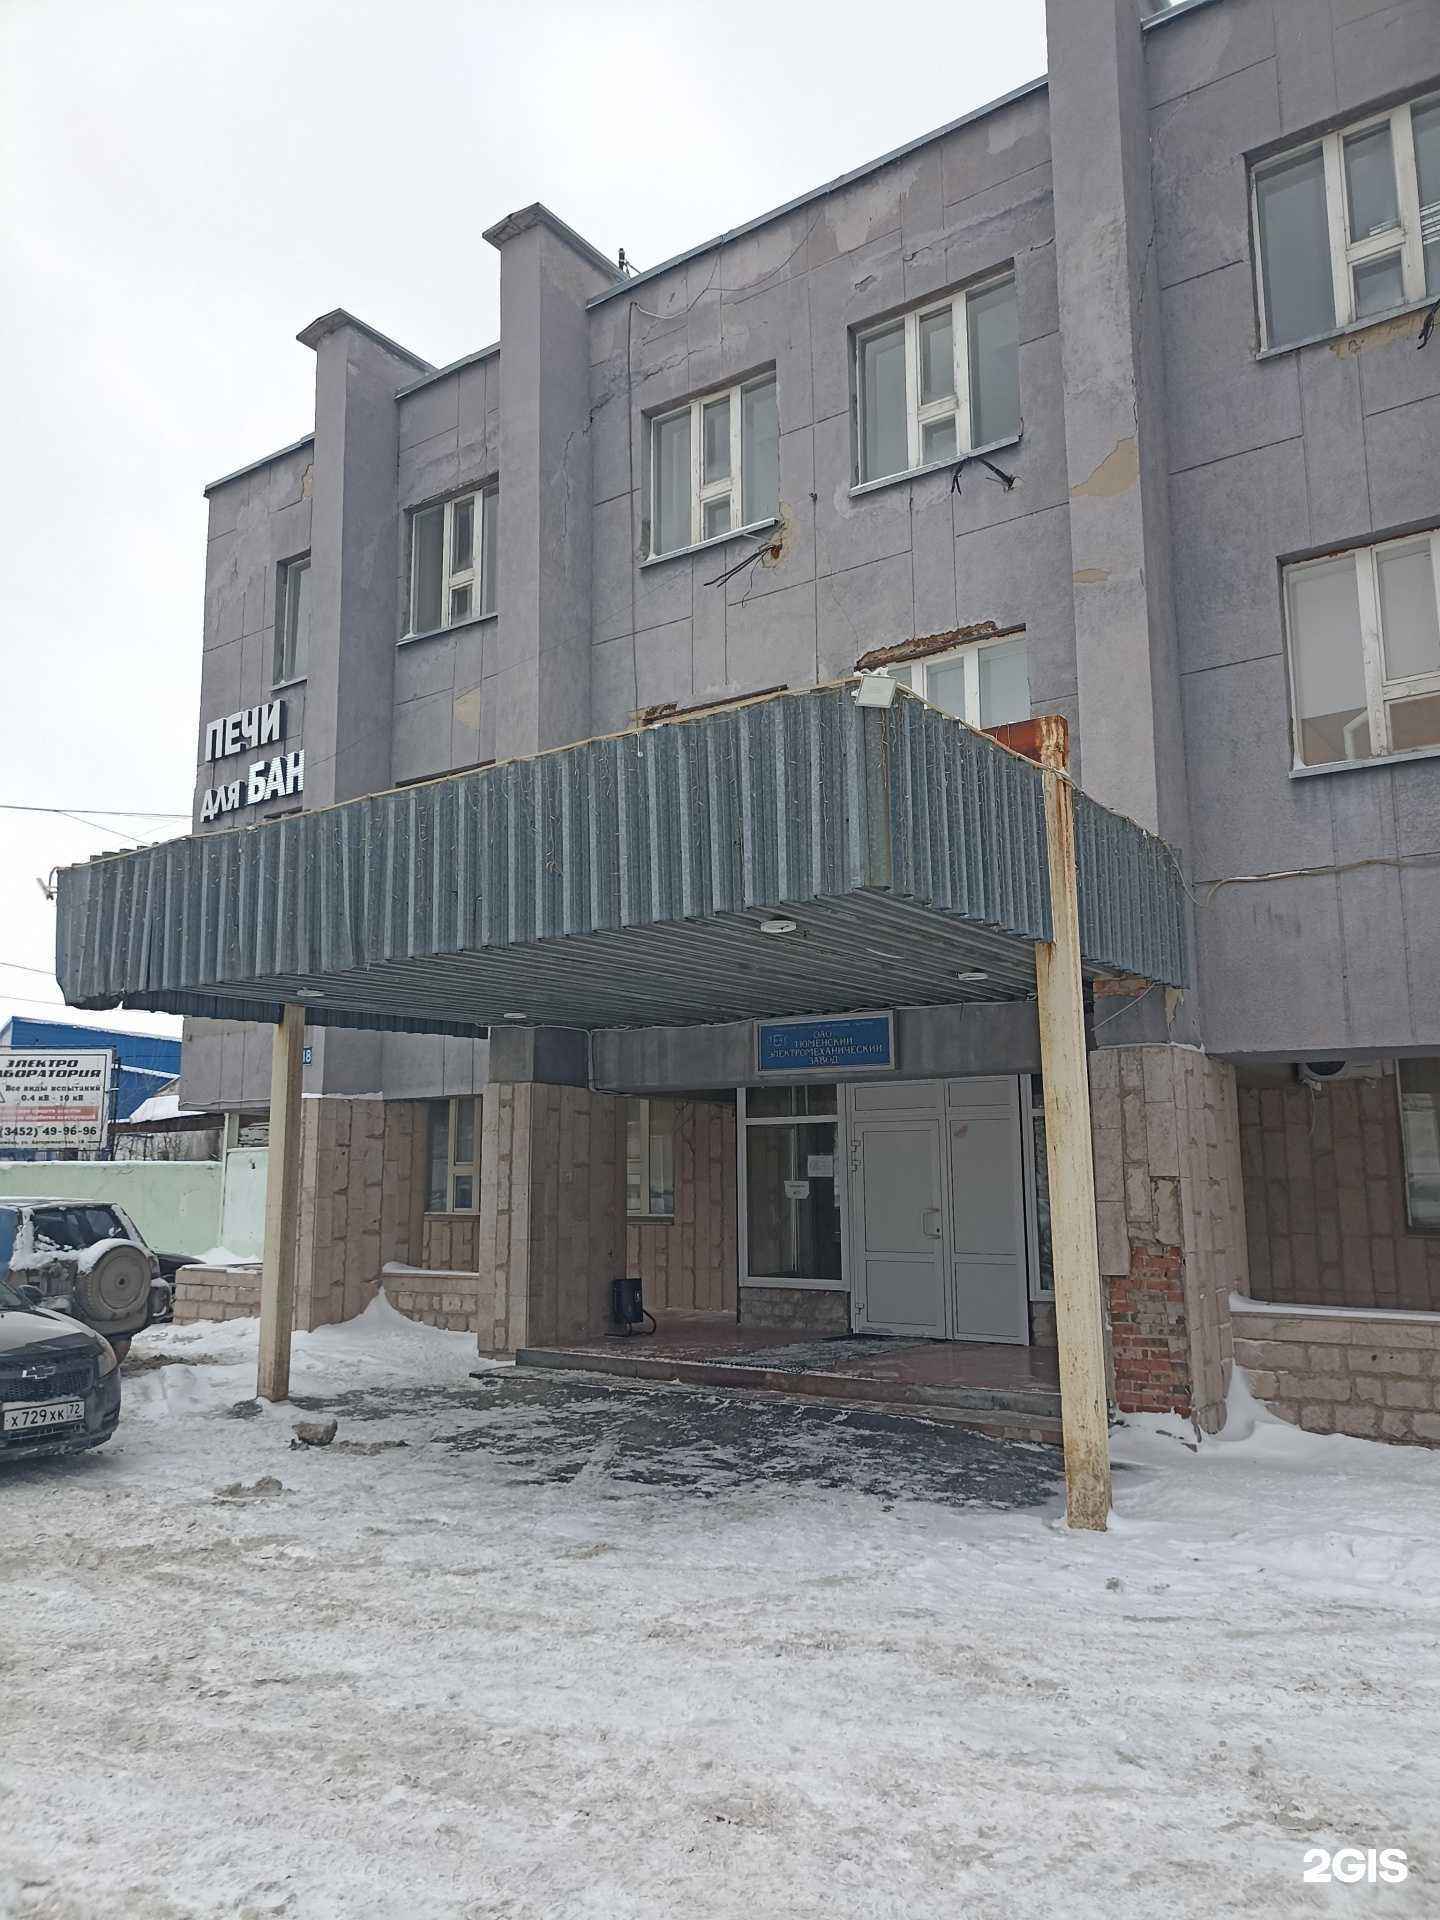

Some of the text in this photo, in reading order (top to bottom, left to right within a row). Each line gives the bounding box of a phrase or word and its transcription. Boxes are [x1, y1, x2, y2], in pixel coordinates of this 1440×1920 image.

[205, 699, 281, 762] ПЕЧИ
[247, 749, 305, 805] БАН
[42, 1126, 97, 1136] 49-96-96
